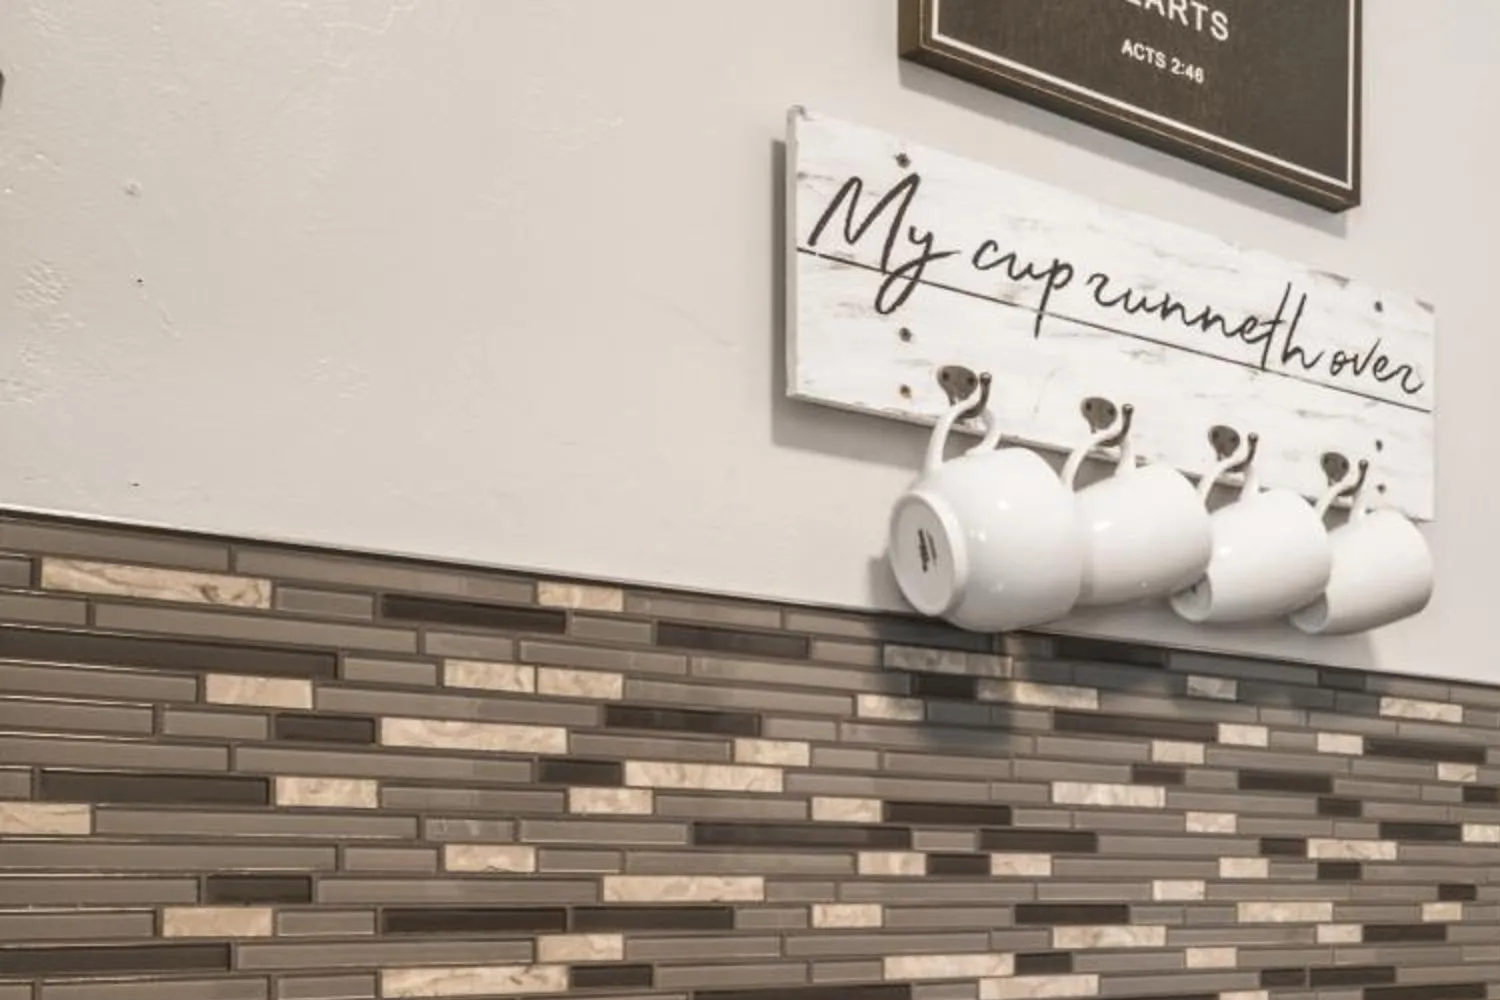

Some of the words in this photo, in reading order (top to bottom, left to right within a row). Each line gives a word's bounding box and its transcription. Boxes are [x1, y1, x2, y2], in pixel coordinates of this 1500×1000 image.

[1127, 0, 1229, 41] ARTS
[1121, 38, 1166, 69] ACTS
[807, 172, 961, 315] My
[972, 239, 1074, 338] cup
[1086, 273, 1325, 371] runneth
[1330, 337, 1425, 394] over
